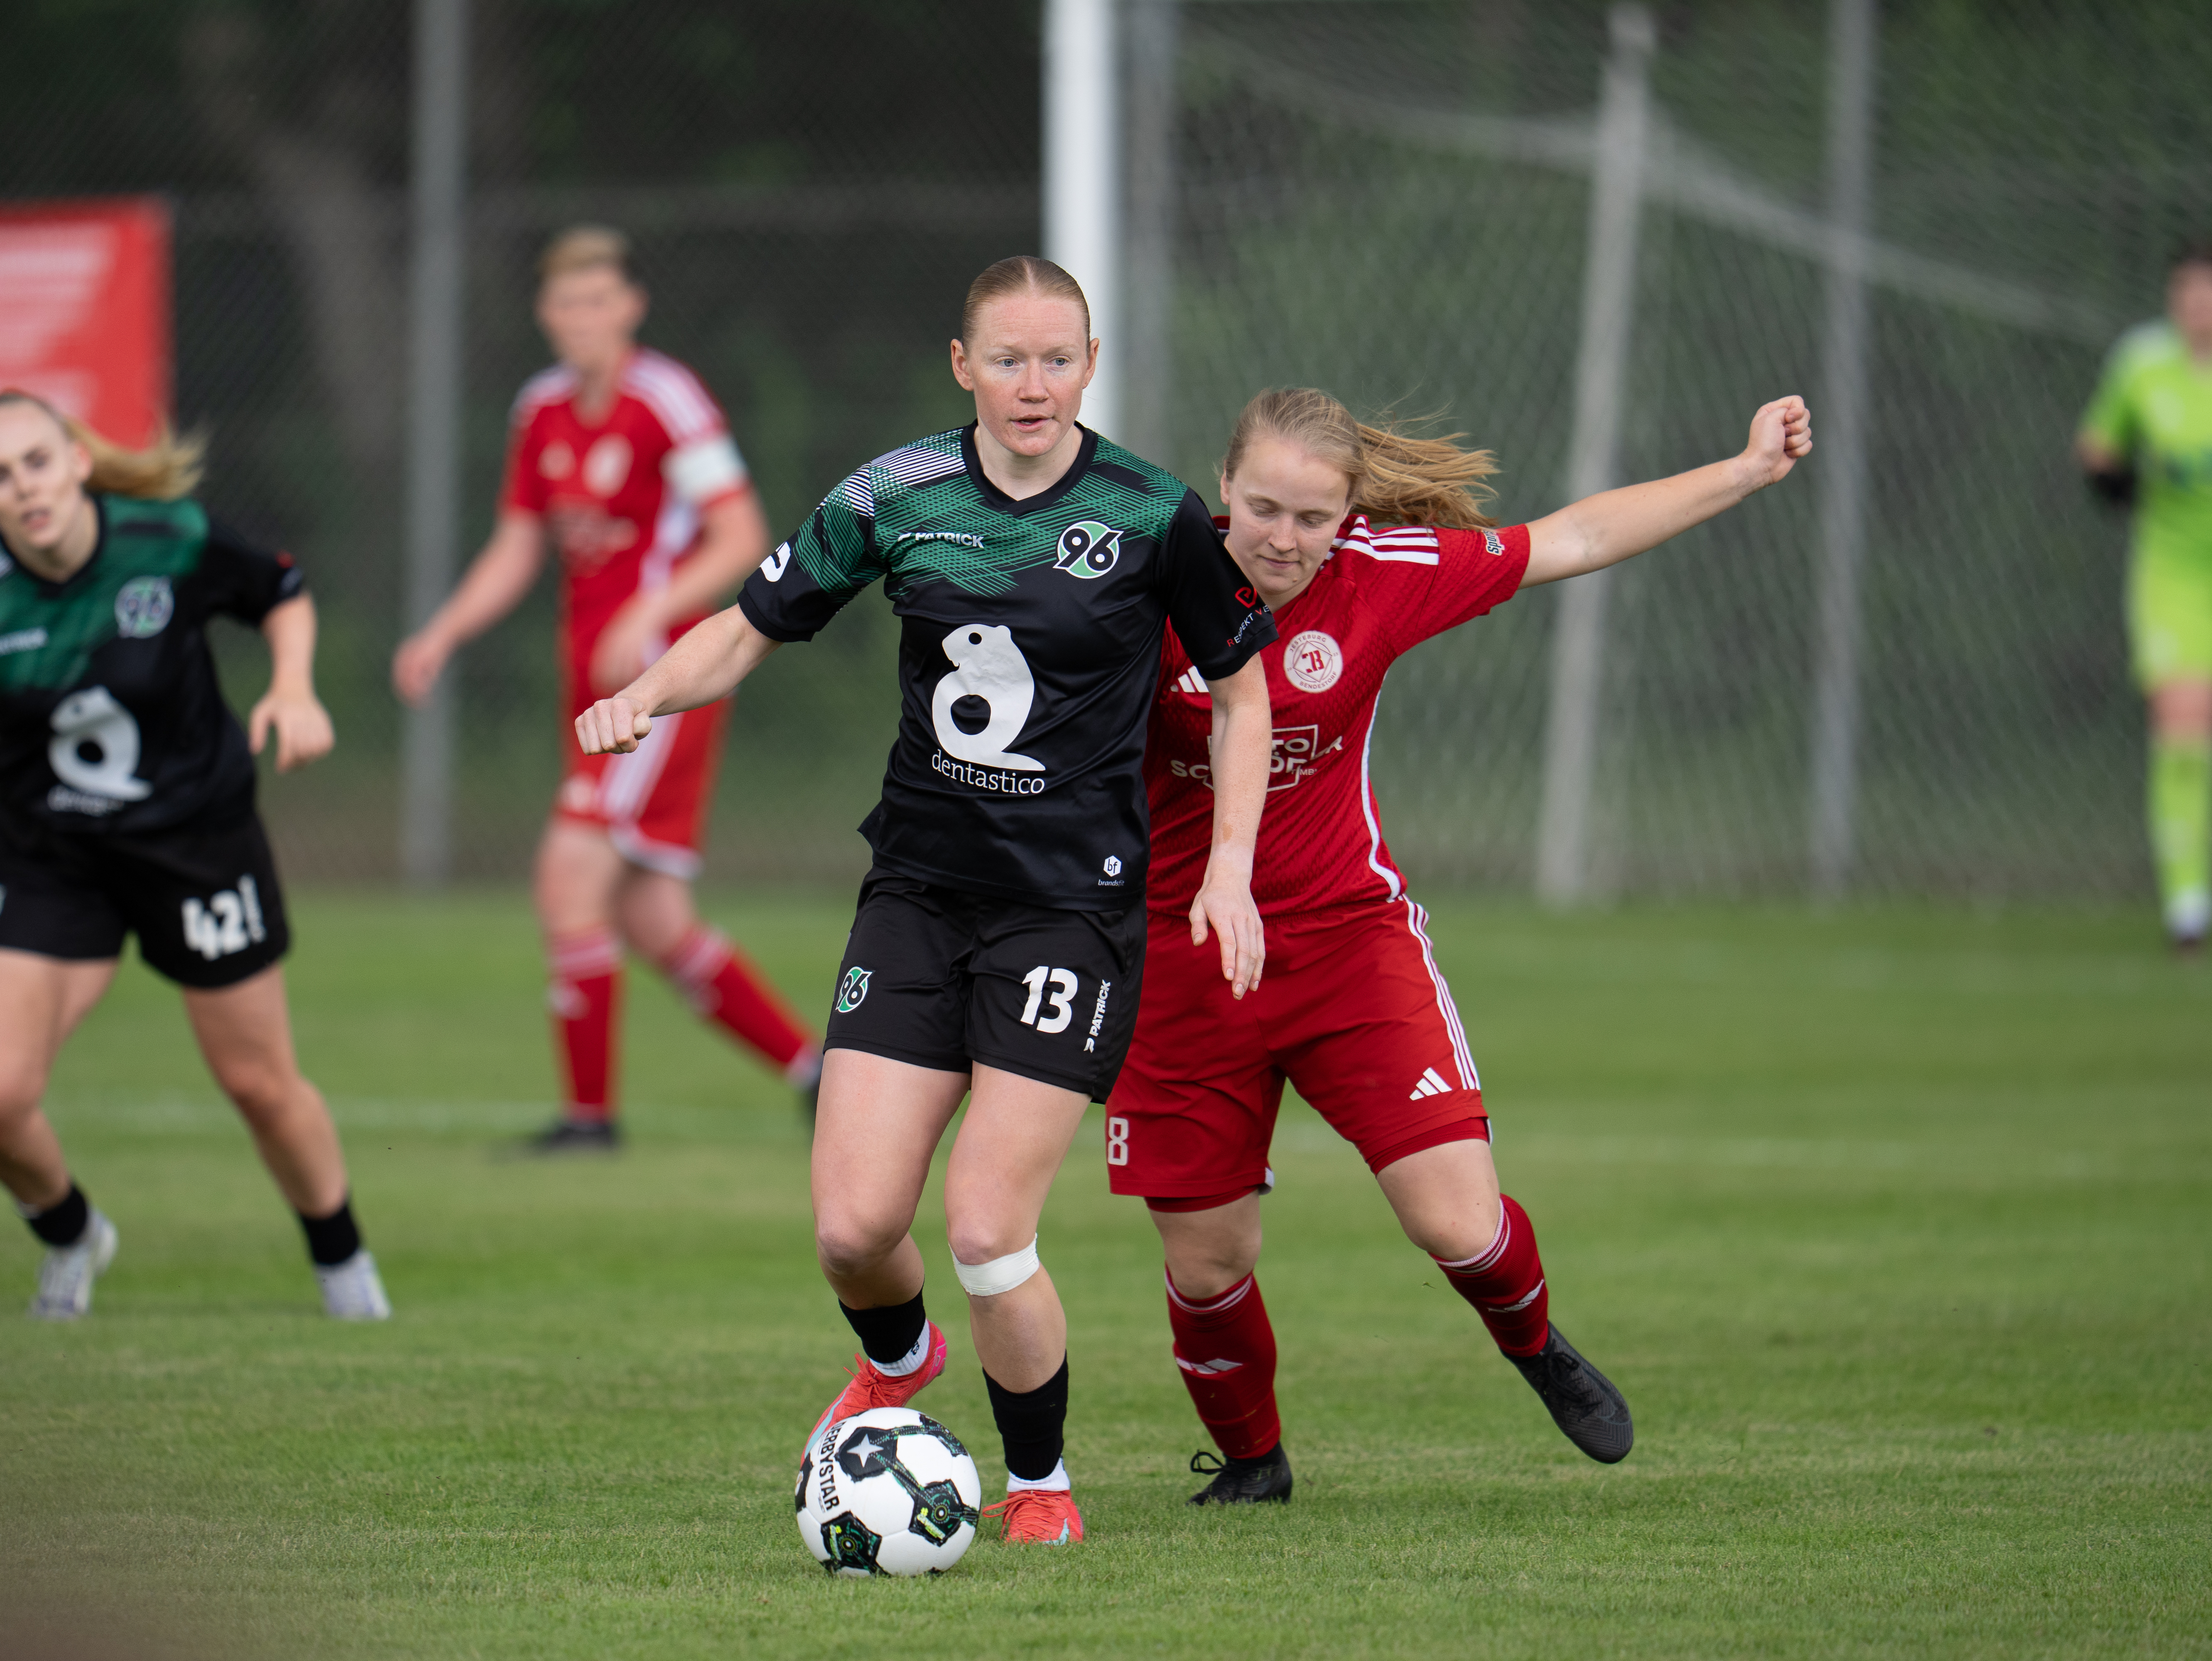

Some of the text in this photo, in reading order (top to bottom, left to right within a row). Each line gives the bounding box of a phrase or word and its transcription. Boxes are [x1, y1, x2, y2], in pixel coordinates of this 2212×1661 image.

[915, 532, 984, 548] PATRICK
[1053, 525, 1124, 574] 96
[1227, 613, 1253, 647] RESPEKT
[1290, 635, 1326, 652] JESTEBURG
[1299, 671, 1337, 689] BENDESTORF
[932, 749, 1045, 794] dentastico
[835, 971, 873, 1010] 96
[1020, 966, 1078, 1033] 13
[1089, 979, 1111, 1037] PATRICK
[819, 1421, 847, 1511] DERBYSTAR
